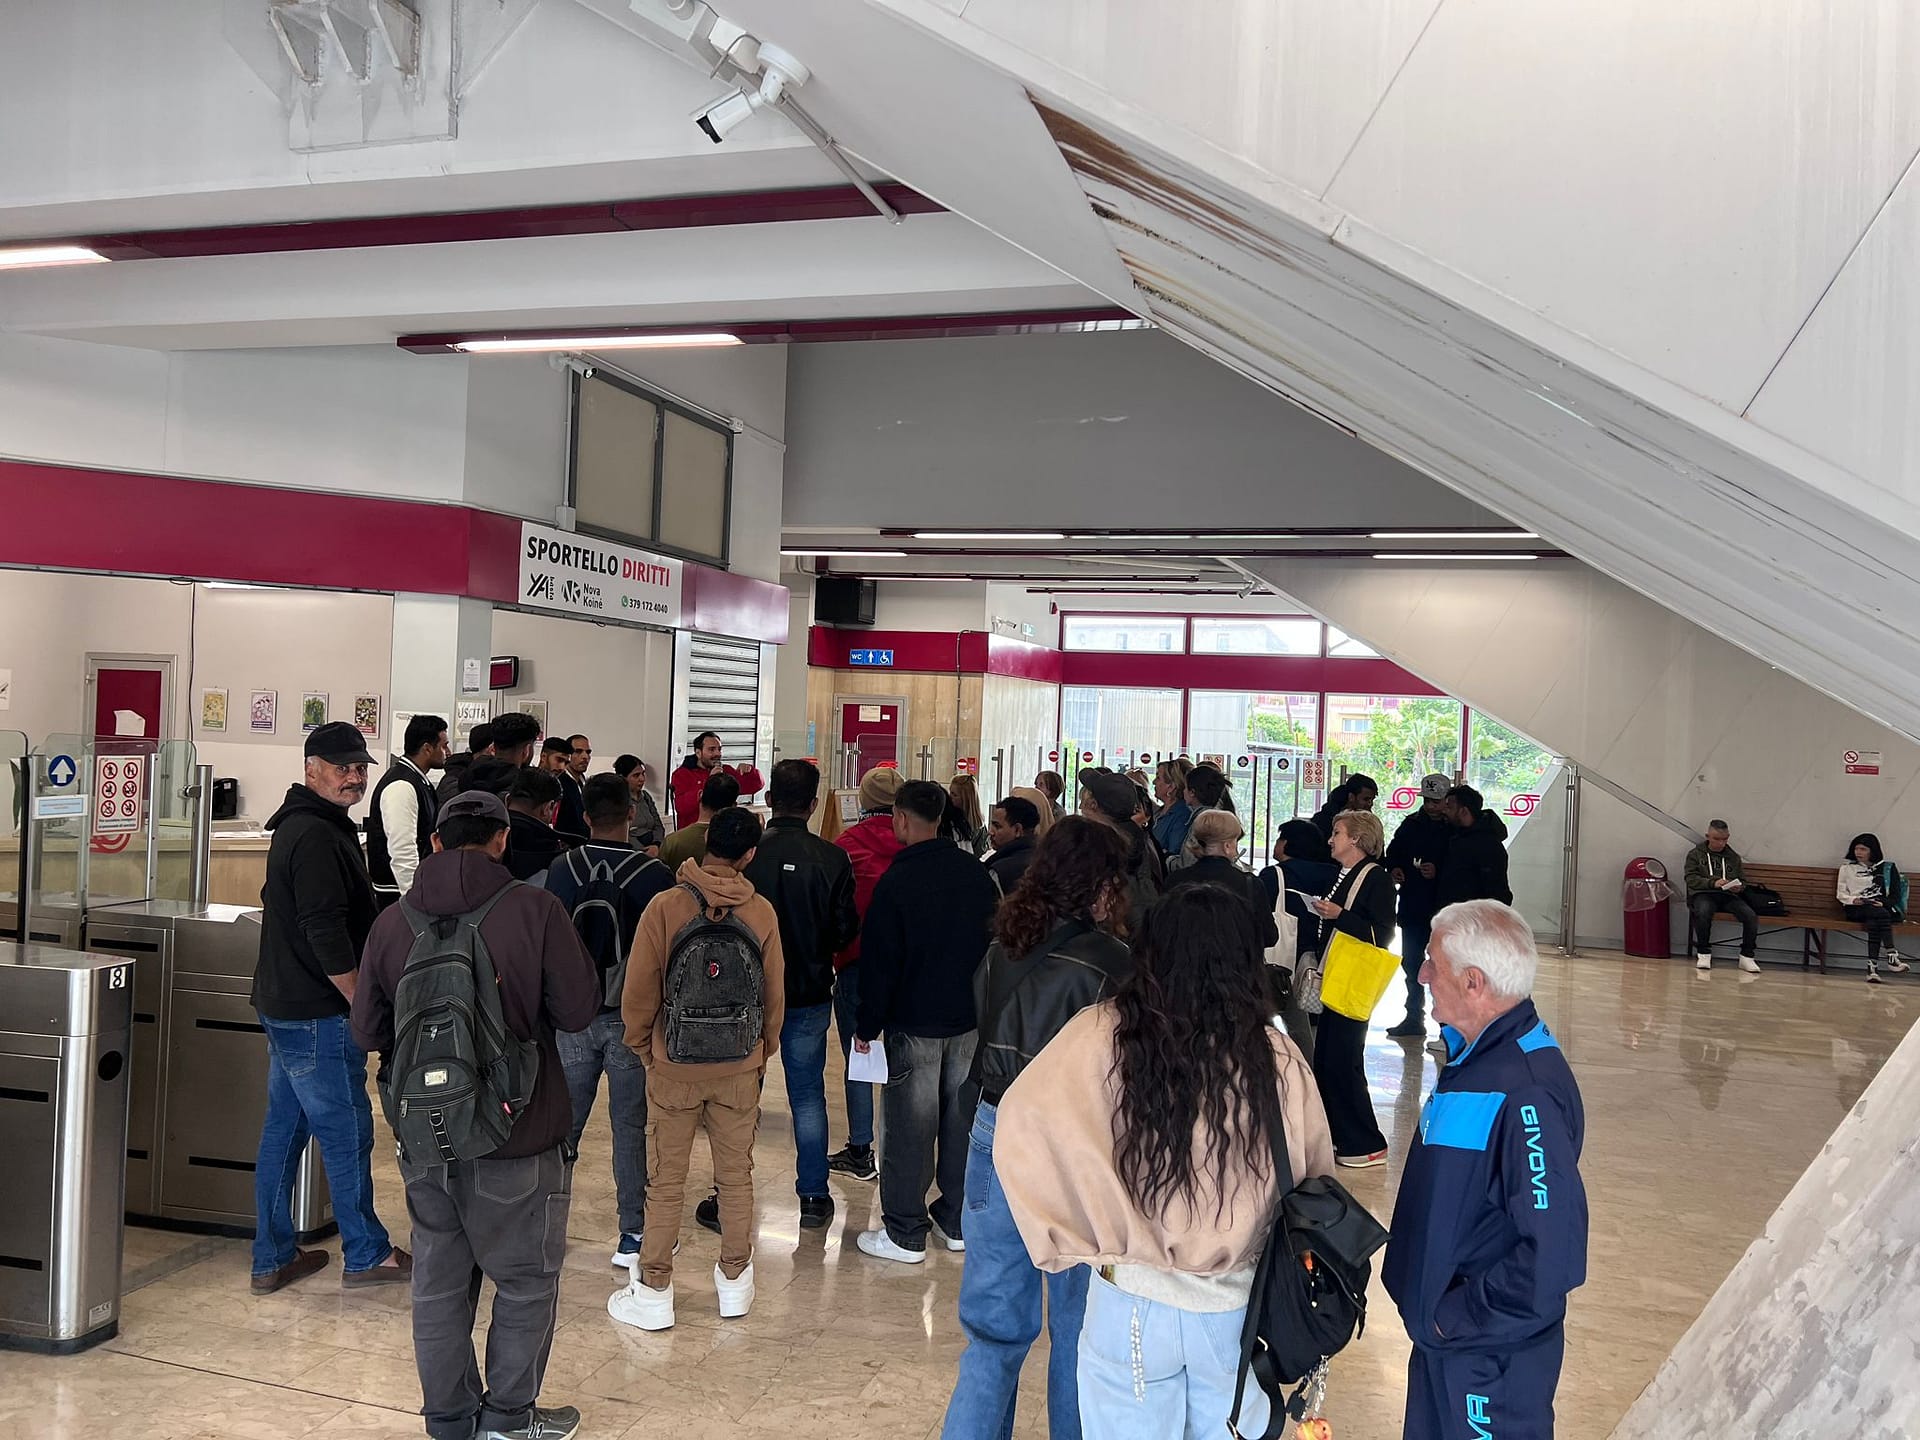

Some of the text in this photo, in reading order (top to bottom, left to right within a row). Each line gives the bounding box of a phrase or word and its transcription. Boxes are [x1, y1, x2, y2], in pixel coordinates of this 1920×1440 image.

[527, 536, 670, 587] SPORTELLO DIRITTI
[583, 583, 601, 596] Nova
[629, 598, 641, 609] 379
[642, 601, 653, 611] 172
[457, 707, 487, 719] USCITA
[113, 967, 122, 987] 8
[1520, 1105, 1549, 1210] GIVOVA
